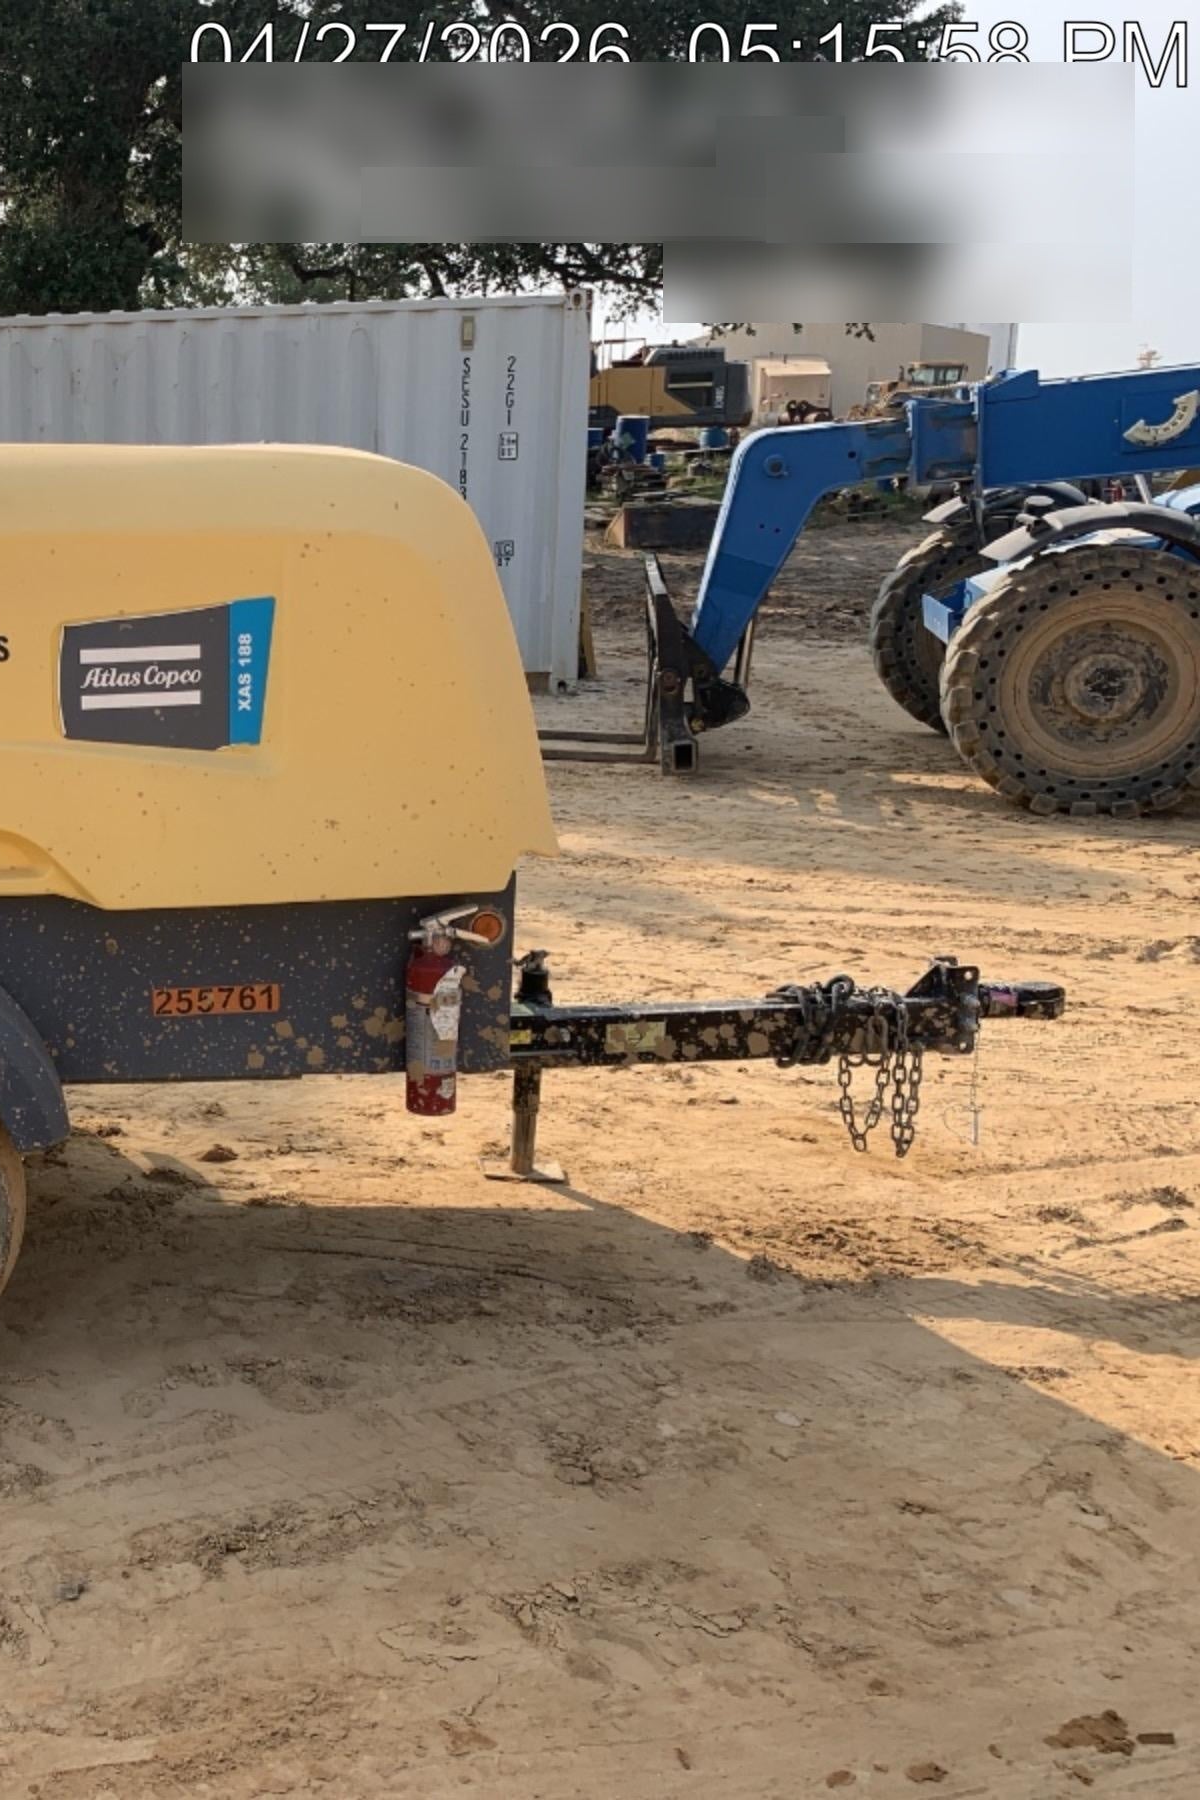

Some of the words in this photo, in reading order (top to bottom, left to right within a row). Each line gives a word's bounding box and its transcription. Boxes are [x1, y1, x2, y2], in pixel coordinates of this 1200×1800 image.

[238, 633, 253, 667] 188
[80, 667, 141, 688] Atlas
[143, 665, 201, 688] Copco
[238, 673, 251, 711] XAS
[155, 985, 274, 1014] 255761
